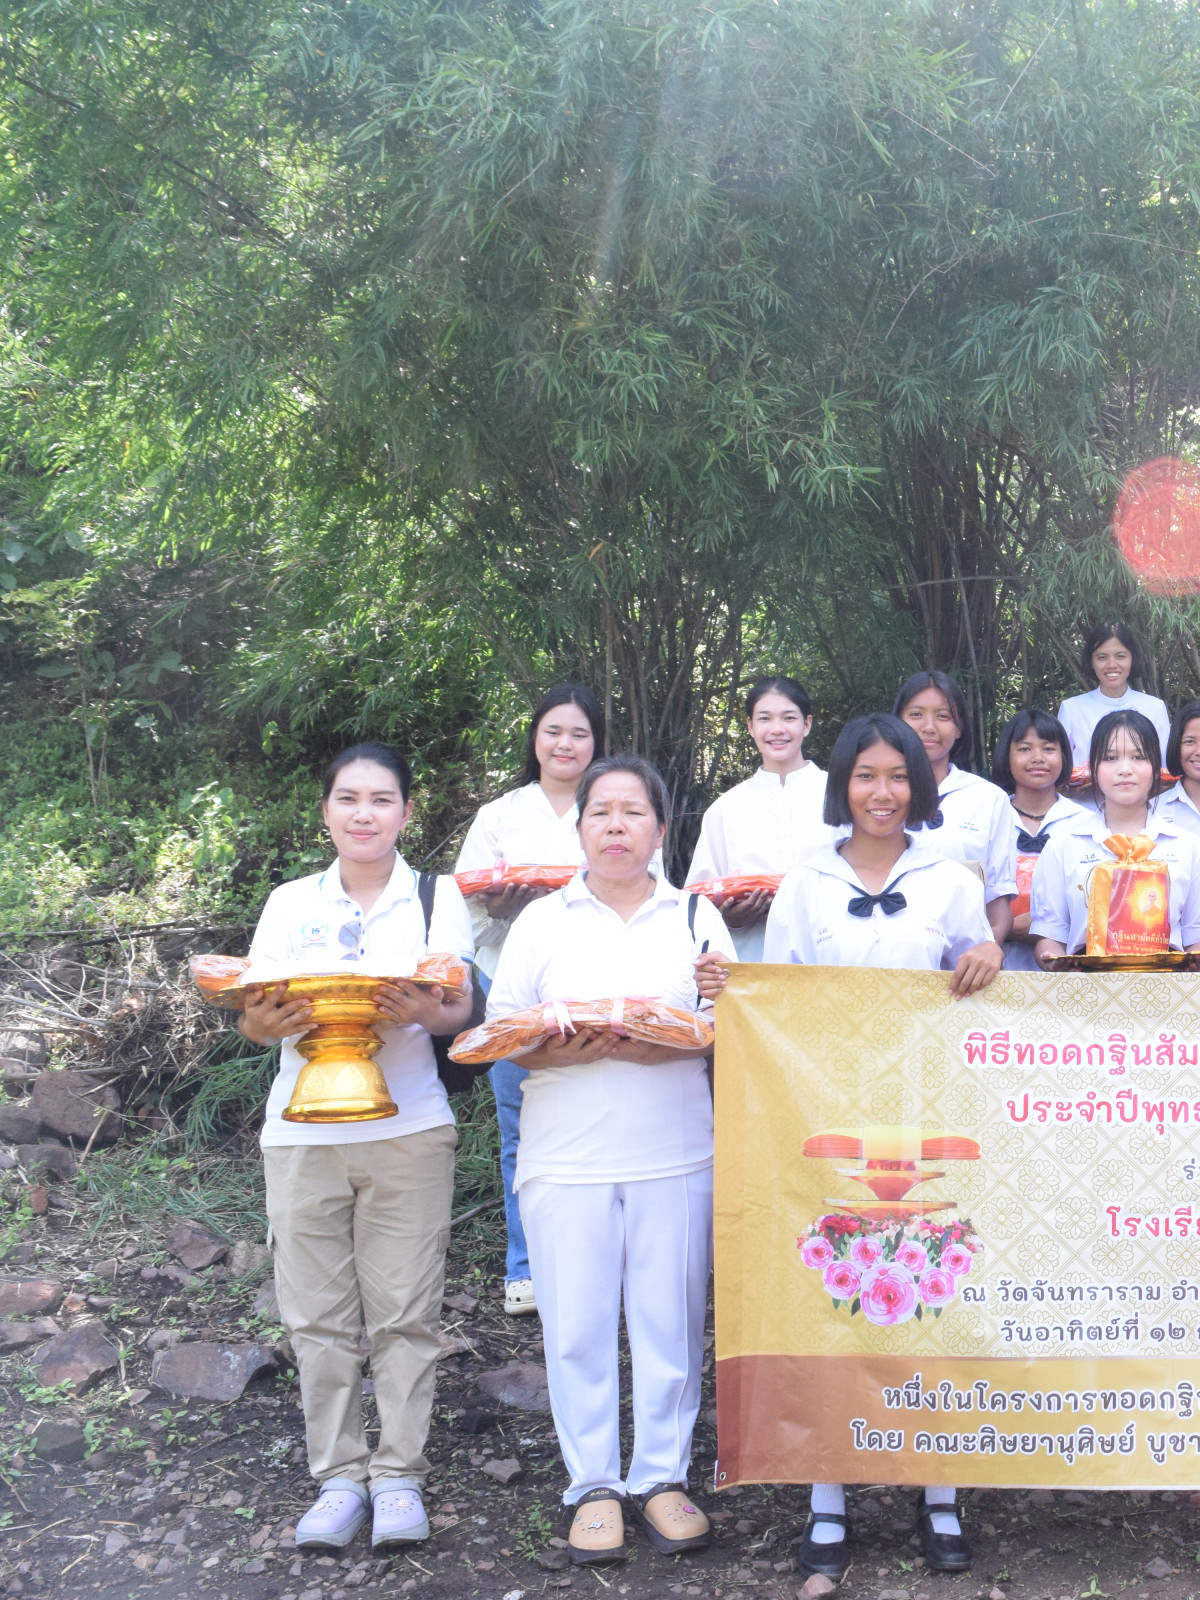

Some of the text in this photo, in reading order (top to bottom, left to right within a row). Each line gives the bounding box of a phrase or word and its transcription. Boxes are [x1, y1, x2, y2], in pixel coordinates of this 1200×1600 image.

[962, 1285, 986, 1302] ณ
[998, 1280, 1162, 1301] วัดจันทราราม
[1001, 1312, 1139, 1342] วันอาทิตย์ที่
[1150, 1322, 1186, 1342] ๑๒
[851, 1419, 904, 1451] โดย
[915, 1421, 1136, 1463] คณะศิษยานุศิษย์
